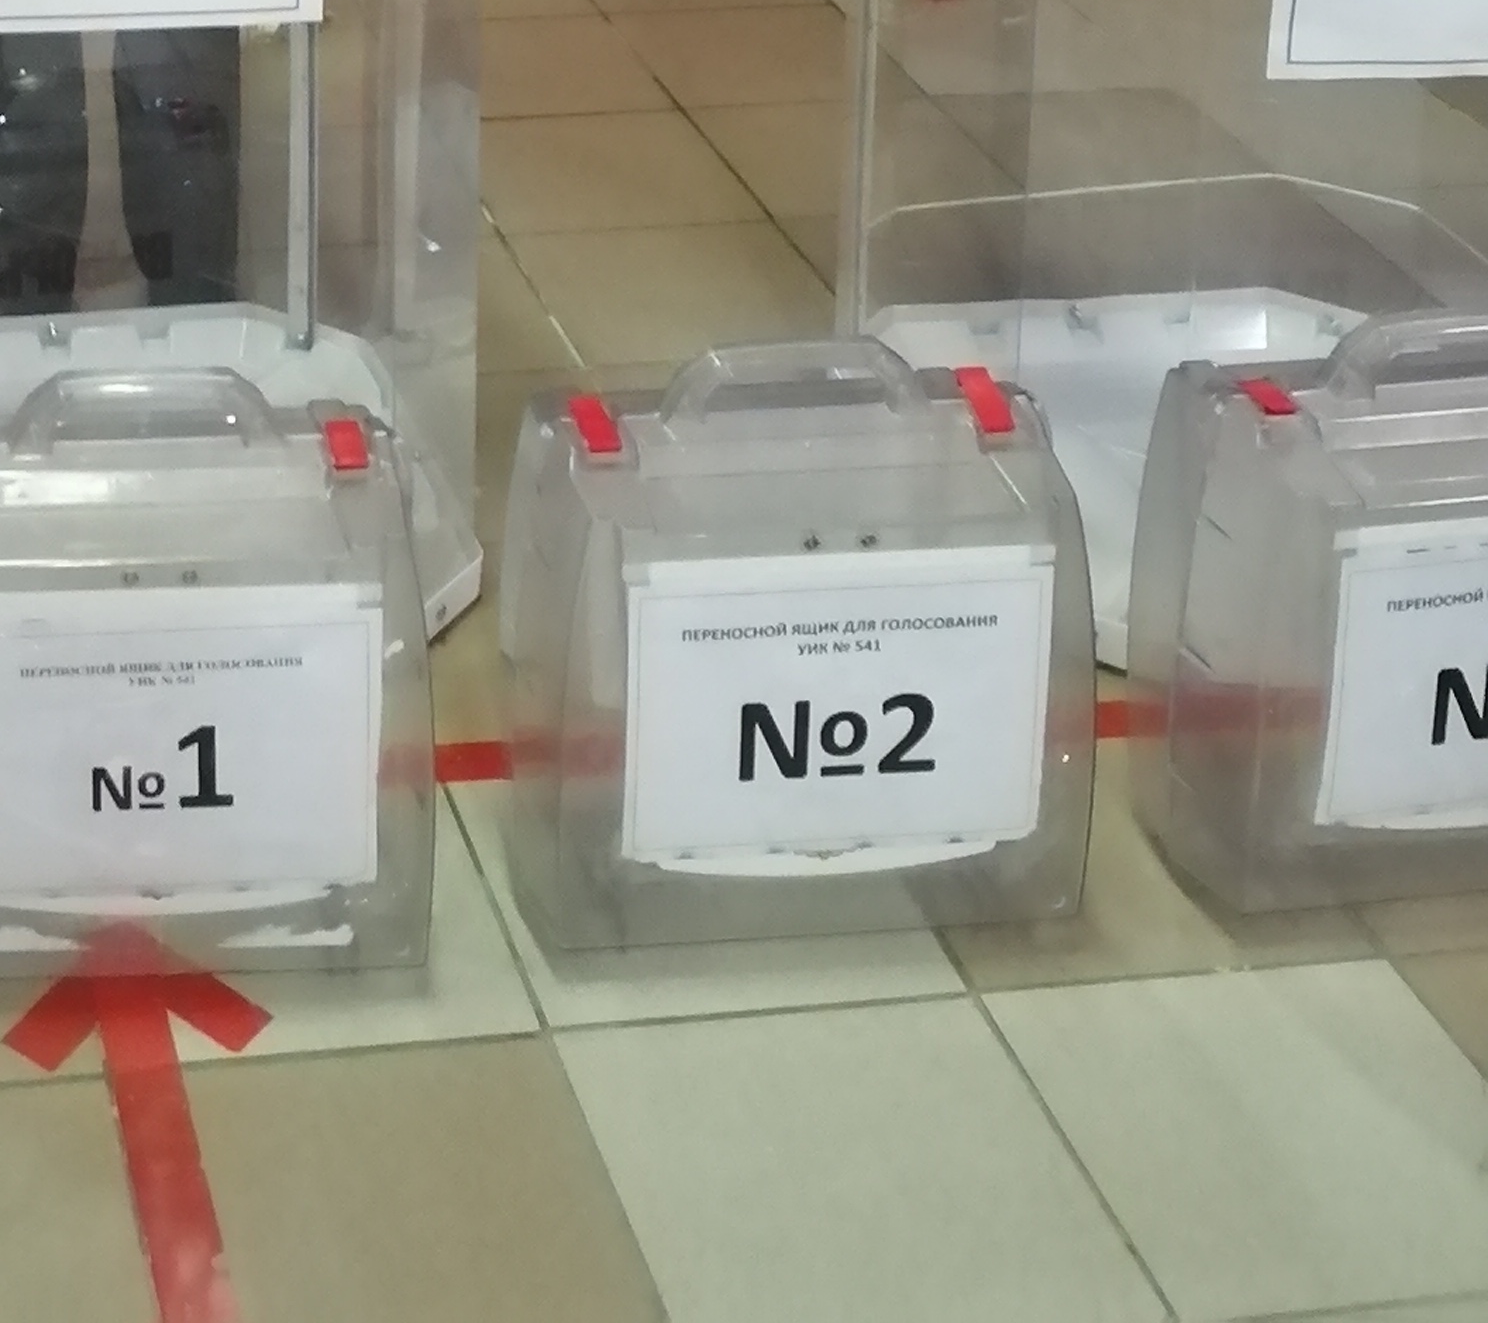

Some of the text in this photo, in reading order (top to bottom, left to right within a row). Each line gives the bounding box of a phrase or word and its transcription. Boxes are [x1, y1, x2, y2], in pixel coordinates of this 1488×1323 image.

[1386, 587, 1484, 612] ПЕРЕНОСНОЙ
[681, 614, 999, 642] ПЕРЕНОСНОЙ ЯЩИК ДЛЯ ГОЛОСОВАНИЯ
[797, 642, 829, 656] УИК
[855, 639, 882, 653] 541
[738, 692, 936, 783] №2
[91, 724, 234, 812] №1
